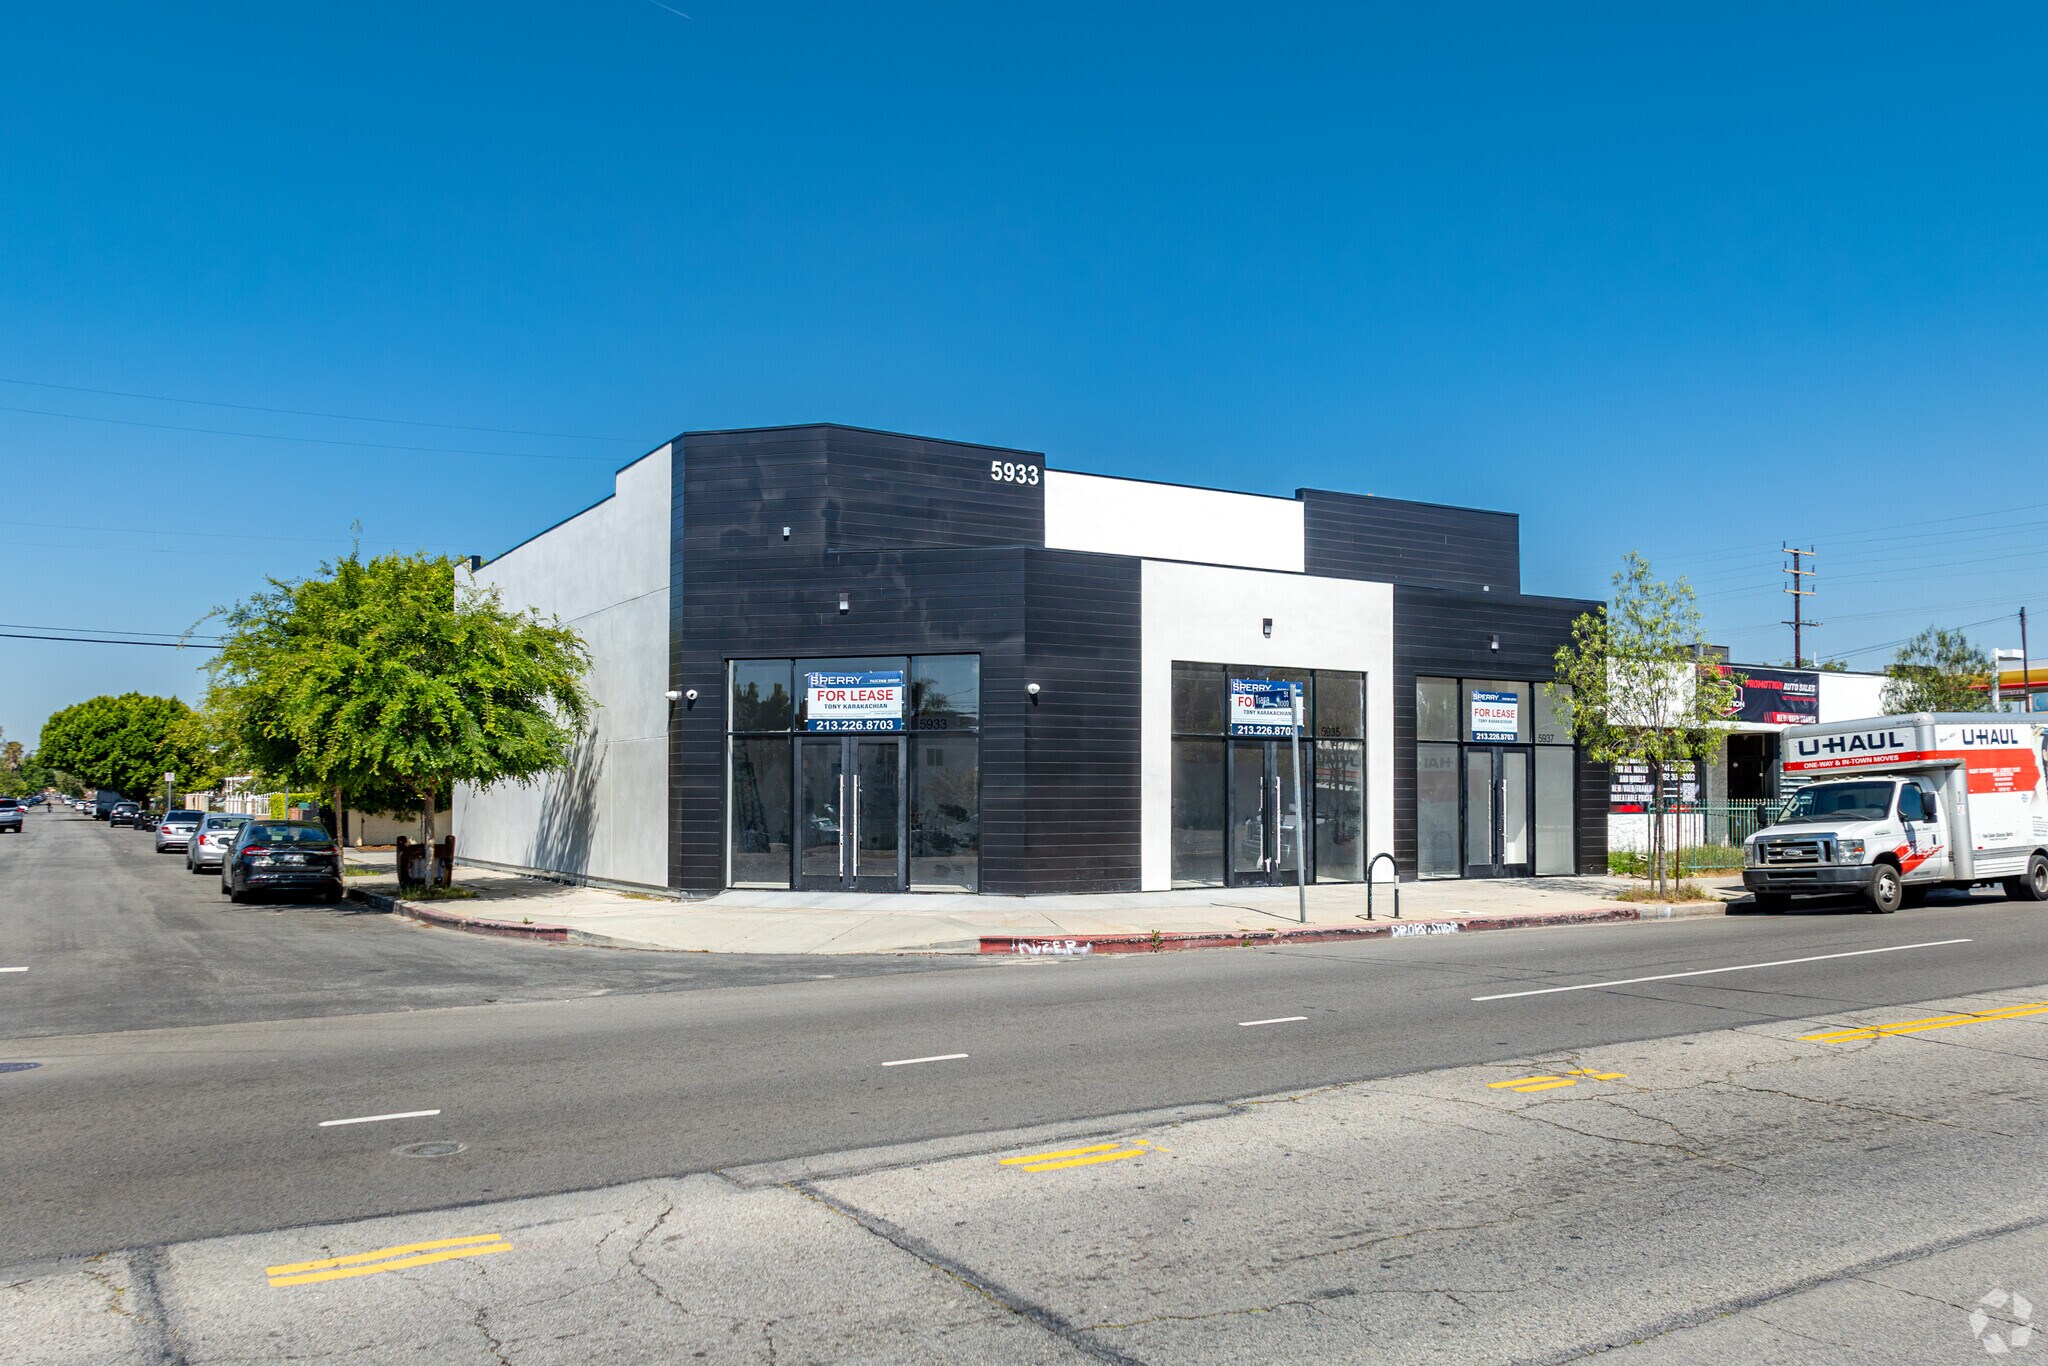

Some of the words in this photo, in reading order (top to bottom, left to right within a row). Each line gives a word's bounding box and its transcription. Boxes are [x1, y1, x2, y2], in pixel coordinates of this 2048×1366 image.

[991, 460, 1039, 485] 5933
[811, 676, 863, 685] SPERRY
[1233, 683, 1272, 692] SPERRY
[1745, 679, 1783, 690] PROMOTION
[1783, 682, 1799, 691] AUTO
[1799, 683, 1816, 693] SALES
[817, 690, 846, 701] FOR
[850, 689, 894, 701] LEASE
[1238, 697, 1254, 707] FO
[1474, 708, 1490, 717] FOR
[1492, 709, 1515, 718] LEASE
[816, 720, 894, 730] 213.226.8703
[919, 718, 947, 730] 5933
[1321, 727, 1341, 737] 5935
[1538, 734, 1554, 743] 5937
[1803, 761, 1834, 769] ONE-WAY
[1842, 757, 1873, 766] IN-TOWN
[1873, 754, 1899, 762] MOVES
